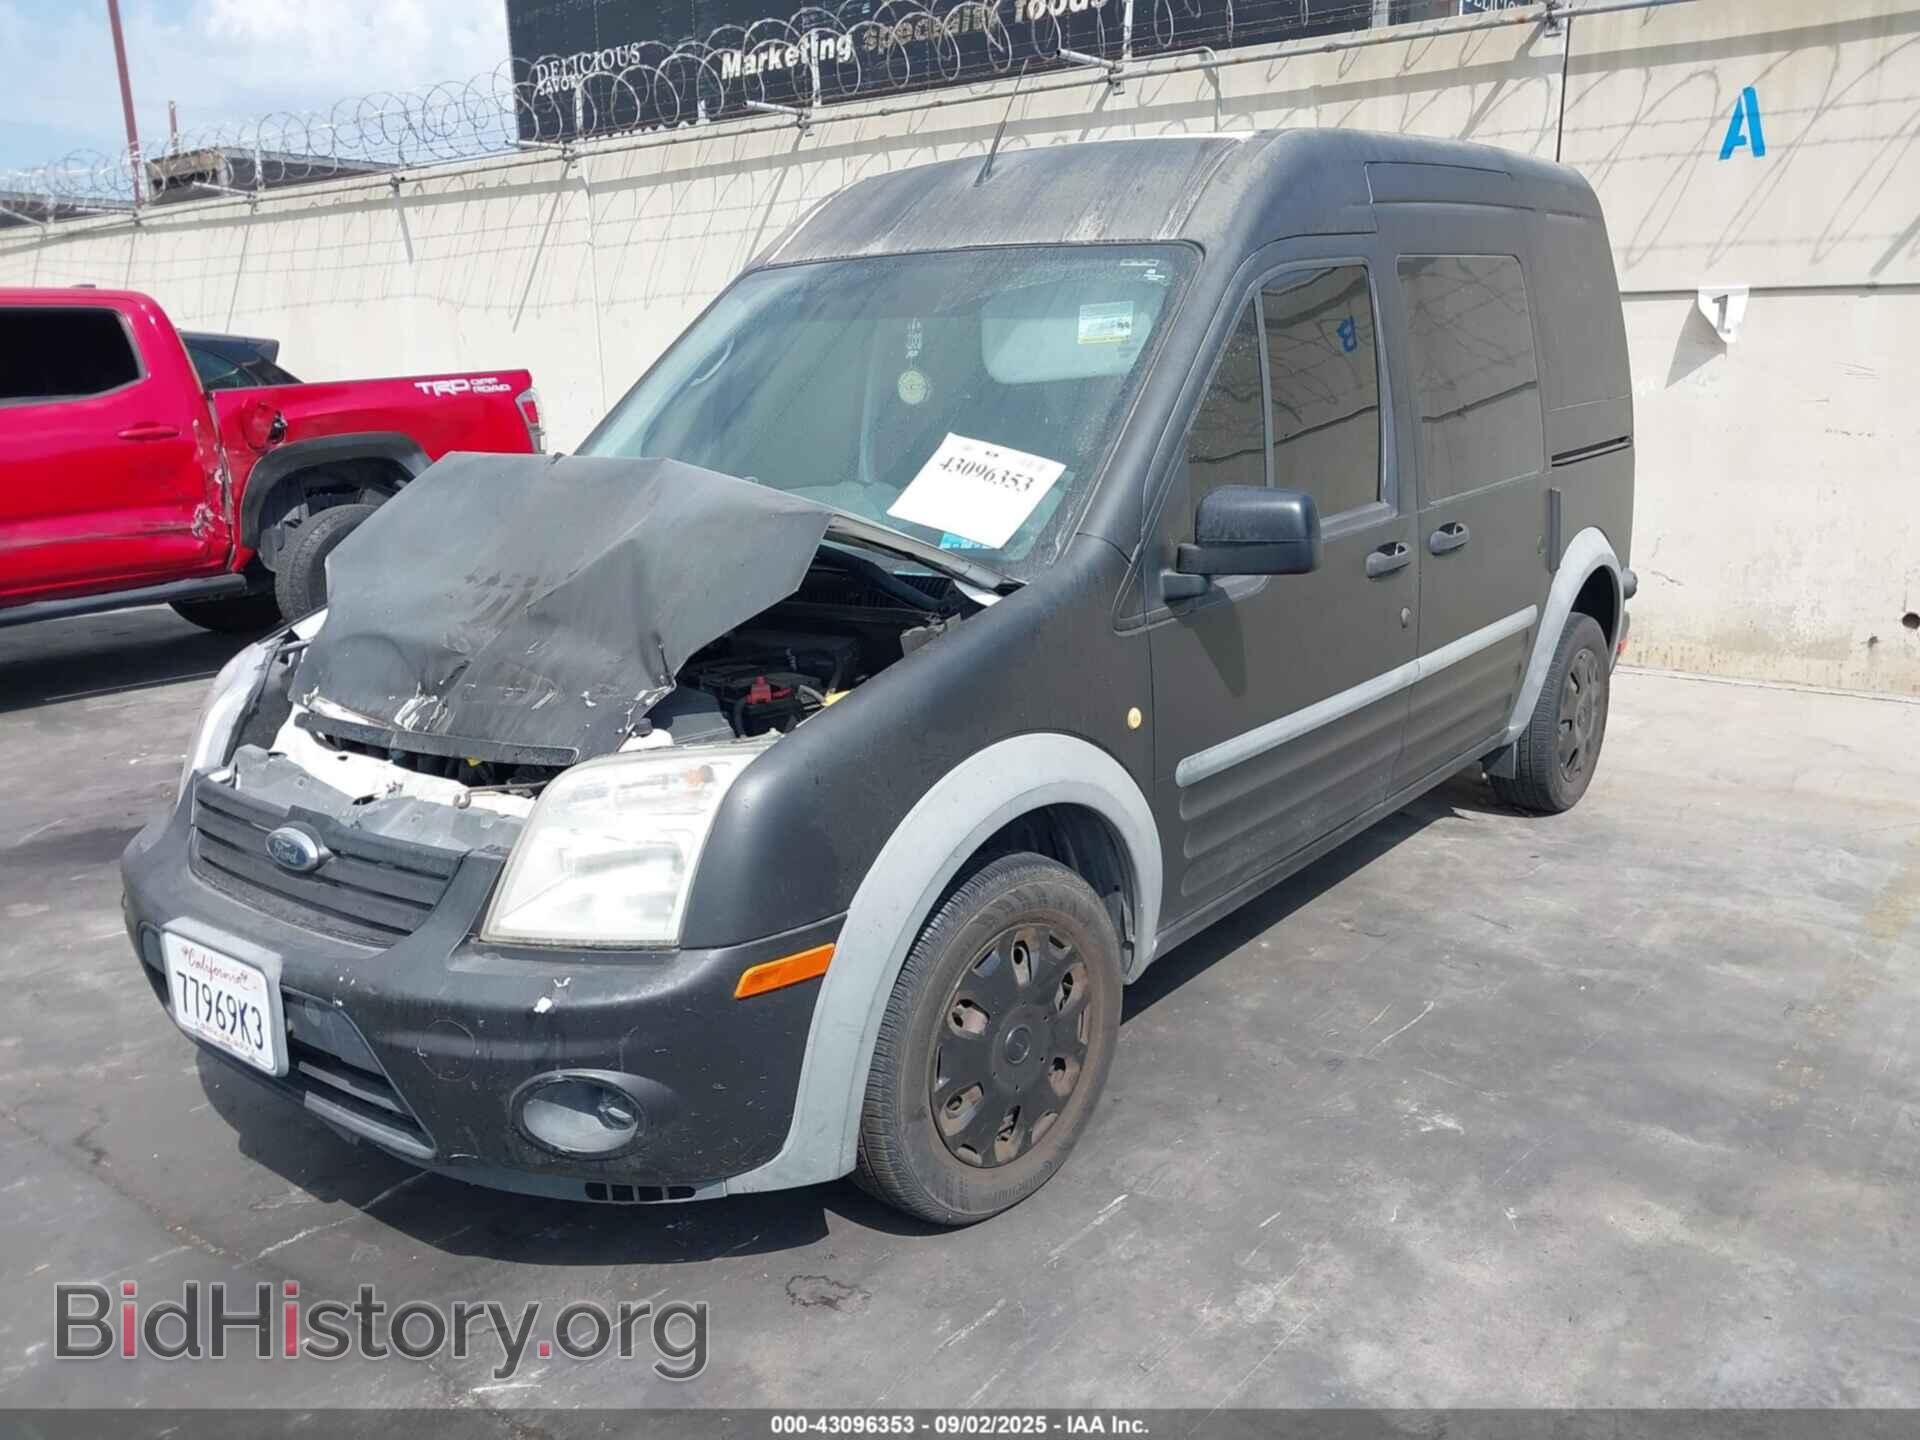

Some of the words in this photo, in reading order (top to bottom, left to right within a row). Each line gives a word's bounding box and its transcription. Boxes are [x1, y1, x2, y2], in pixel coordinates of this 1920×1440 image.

[536, 42, 640, 82] DELICIOUS
[721, 33, 853, 80] Marketing
[1718, 86, 1766, 160] A
[1711, 294, 1732, 334] 1
[414, 379, 470, 396] TRD
[940, 457, 1035, 492] 43096353
[188, 949, 245, 984] California
[176, 970, 264, 1050] 77969K3
